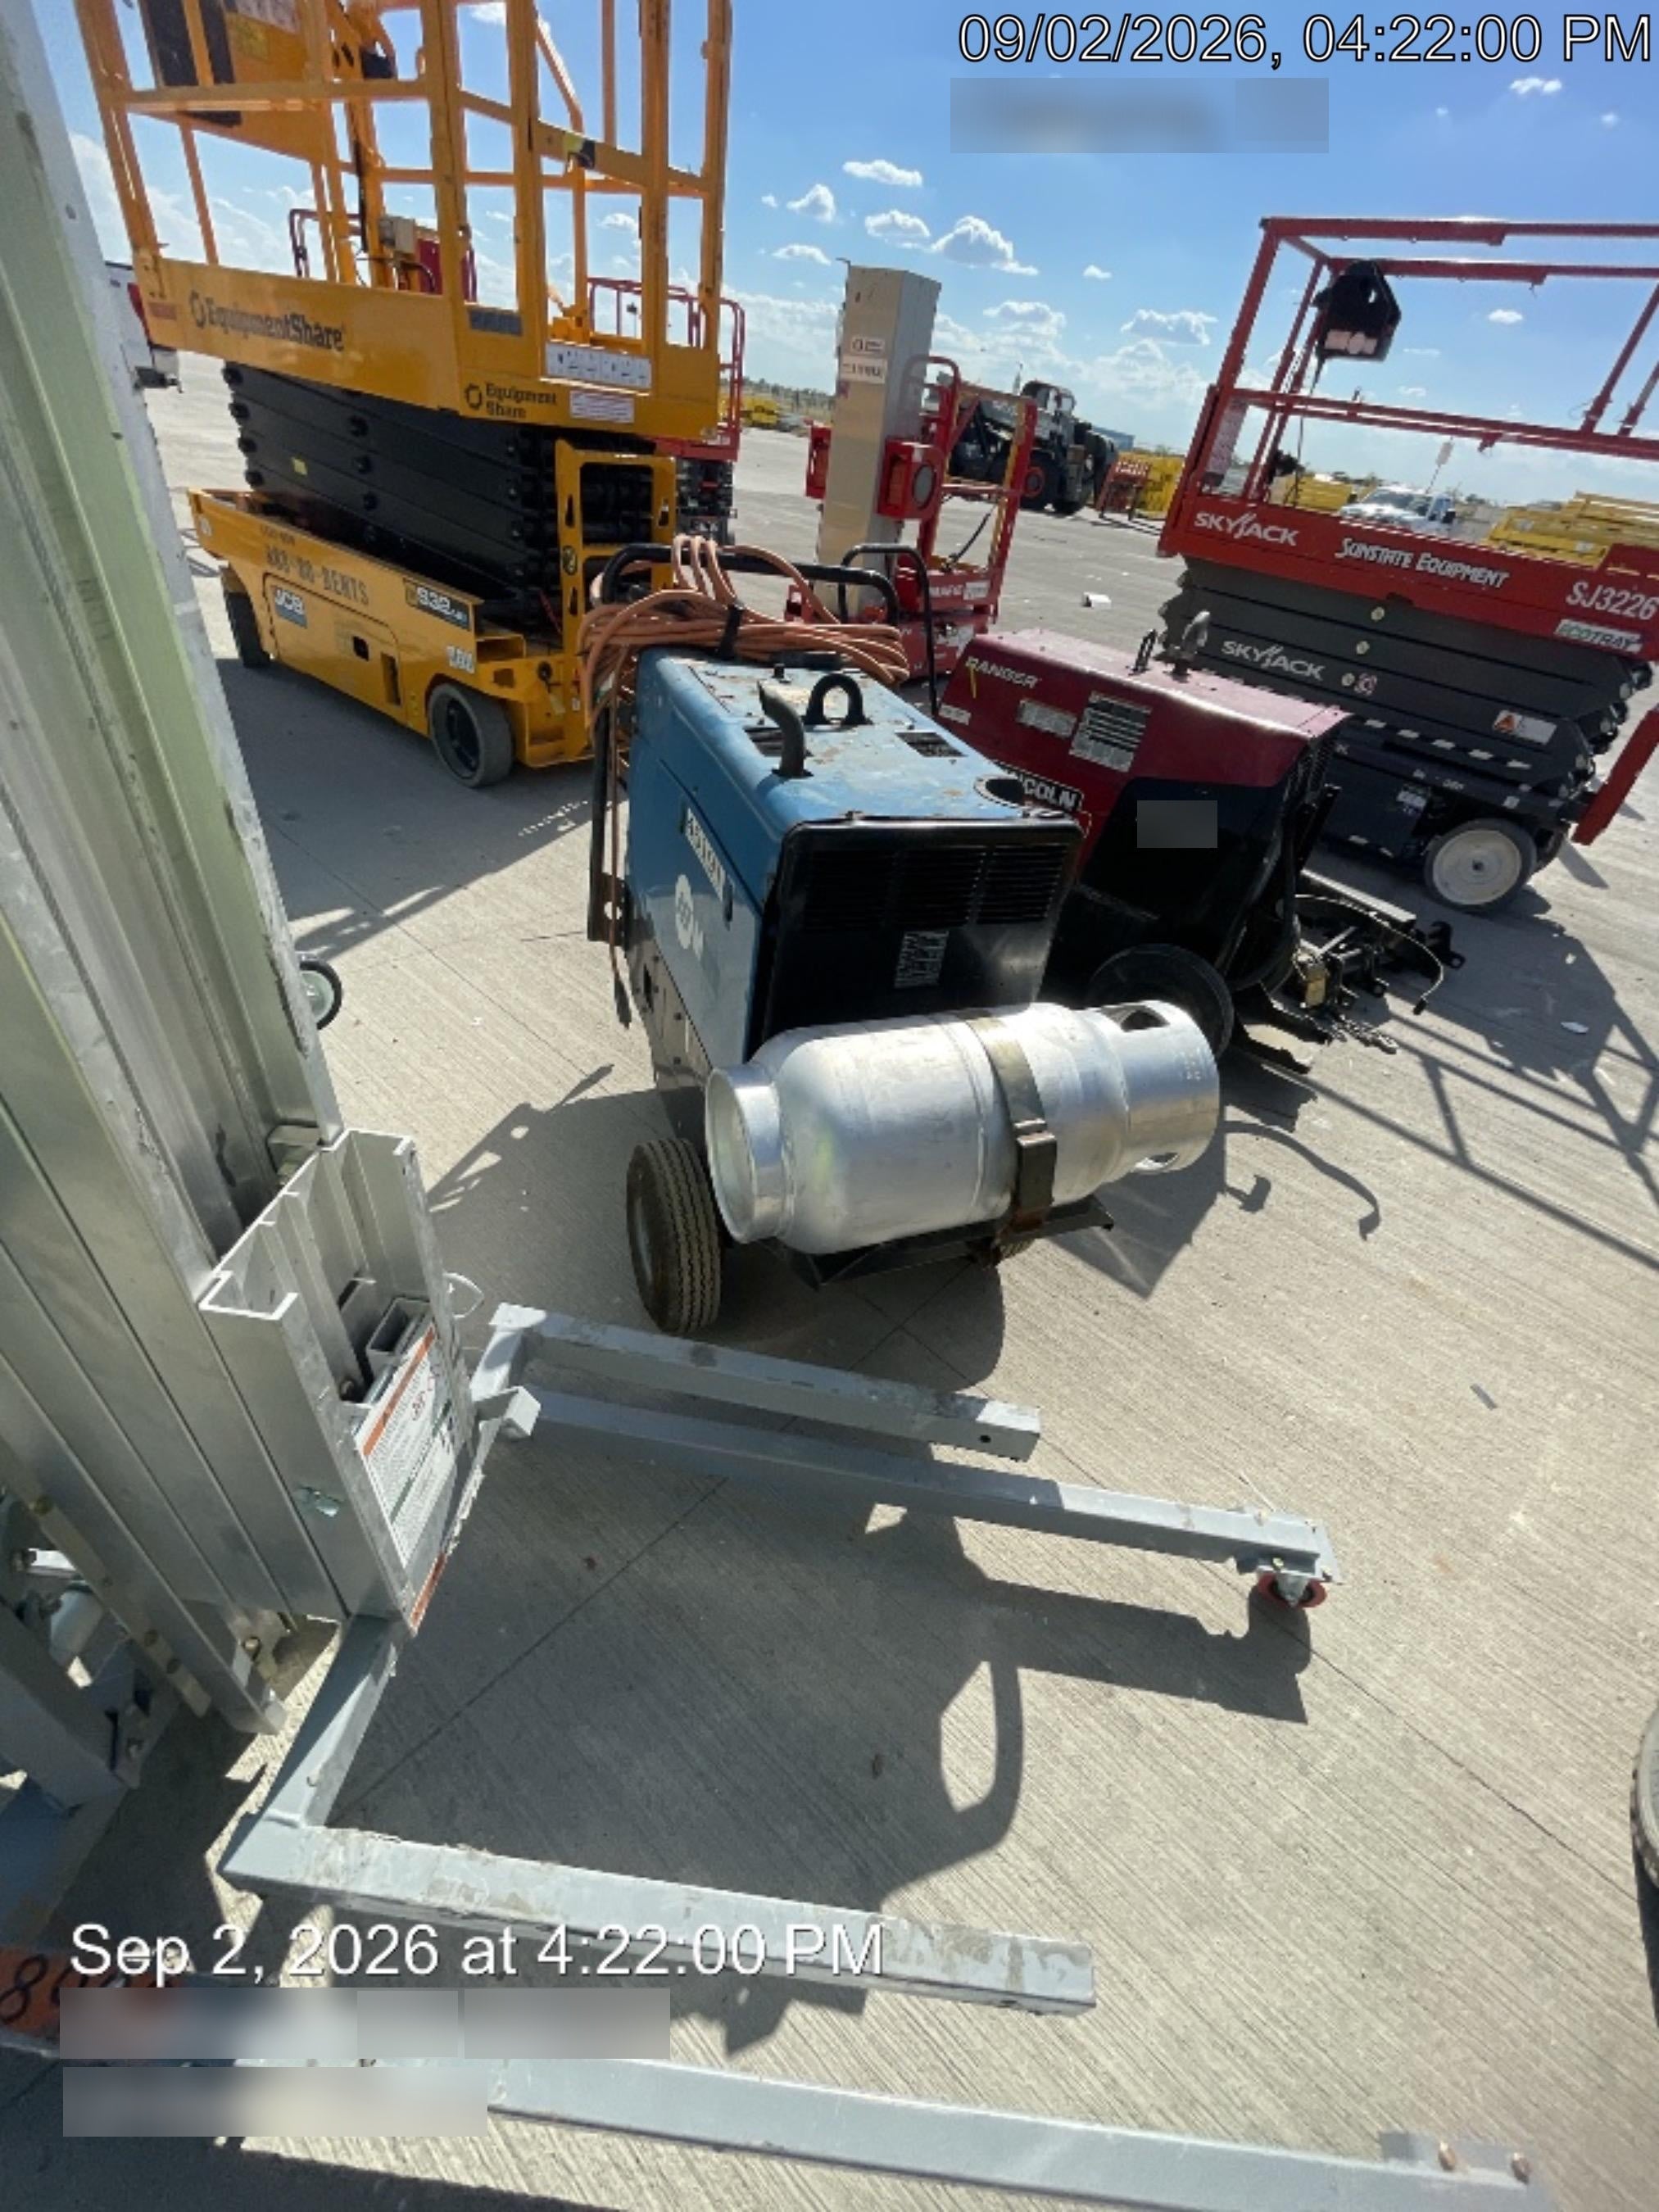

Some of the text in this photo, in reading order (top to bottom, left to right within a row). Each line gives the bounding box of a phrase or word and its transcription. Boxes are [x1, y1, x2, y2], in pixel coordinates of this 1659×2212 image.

[1194, 510, 1299, 547] SKYJACK
[1565, 581, 1659, 620] SJ3226
[965, 656, 1040, 689] RANGER
[1221, 641, 1326, 682] SKYJACK
